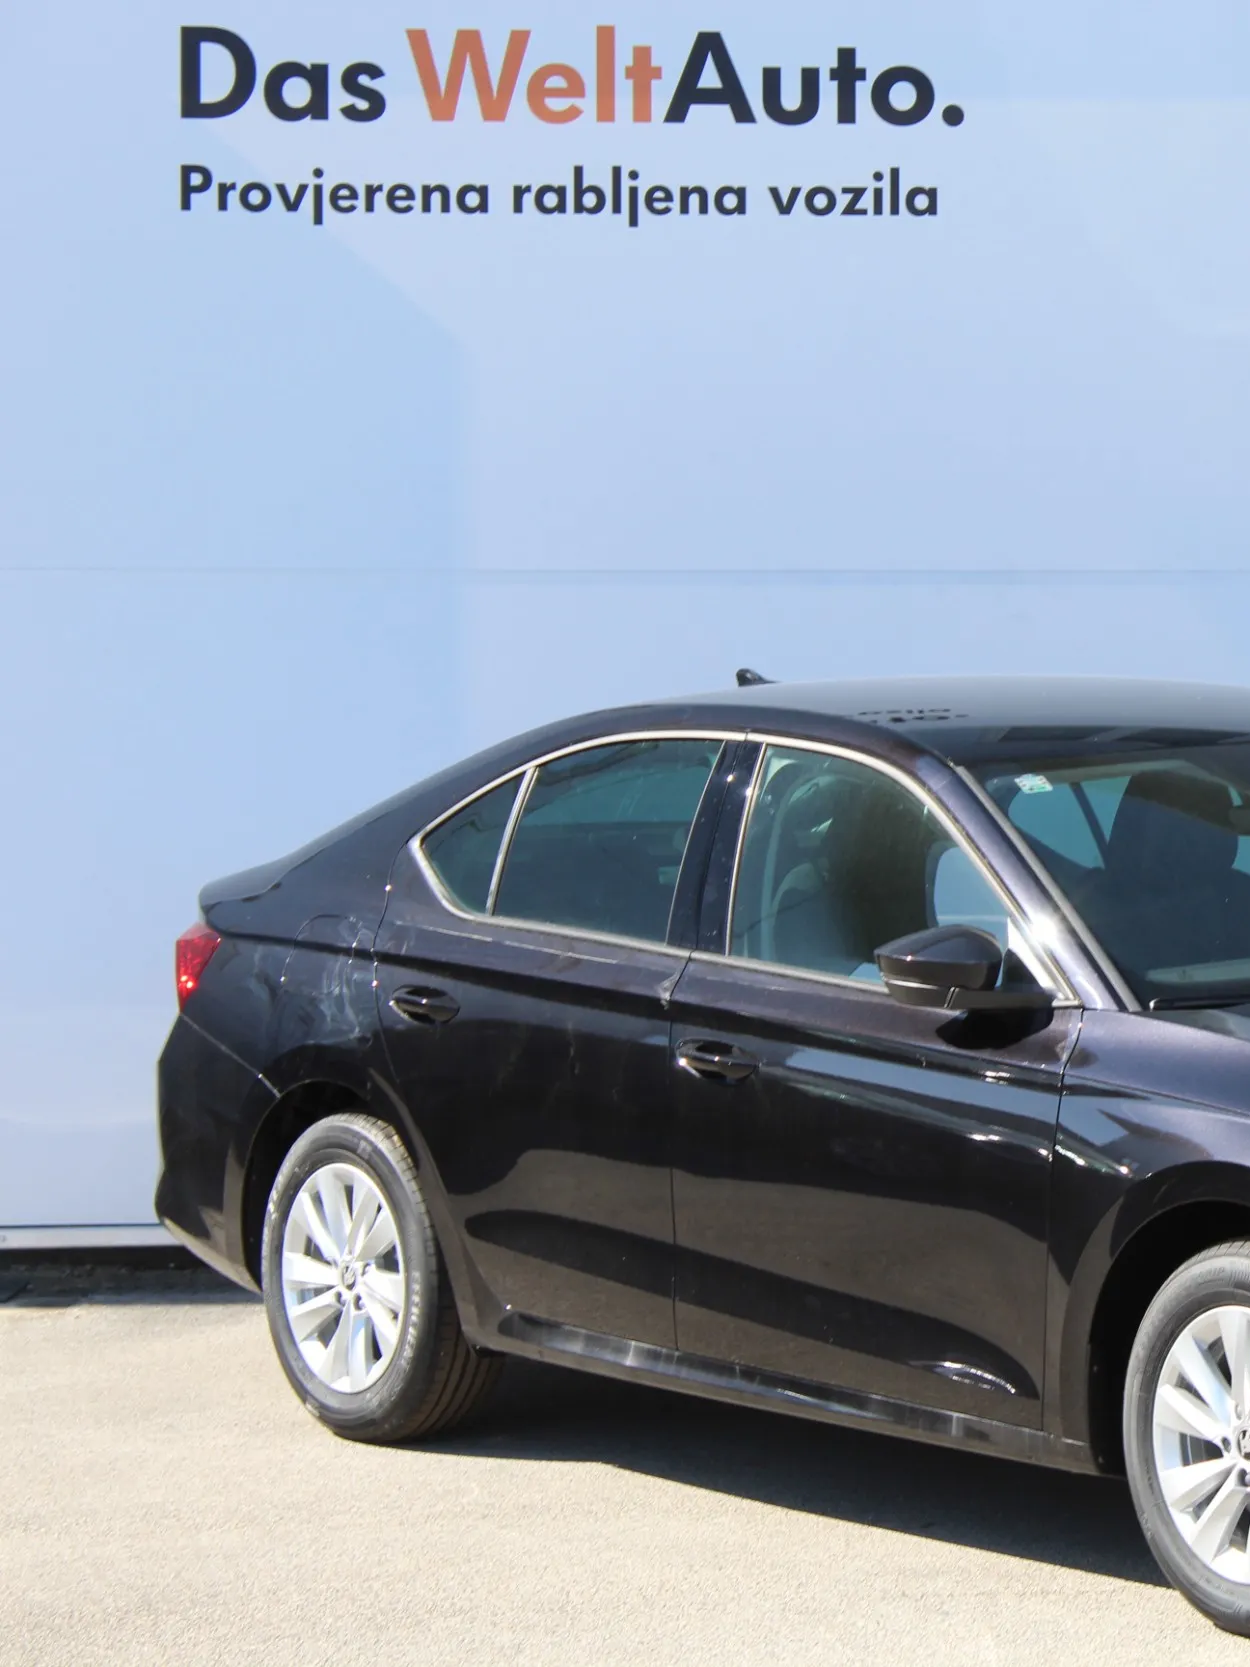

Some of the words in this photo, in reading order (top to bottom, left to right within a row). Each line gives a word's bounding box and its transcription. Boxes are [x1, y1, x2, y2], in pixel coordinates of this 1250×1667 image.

[179, 25, 386, 122] Das
[406, 25, 965, 127] WeltAuto.
[179, 163, 489, 225] Provjerena
[512, 164, 746, 227] rabljena
[767, 166, 938, 217] vozila
